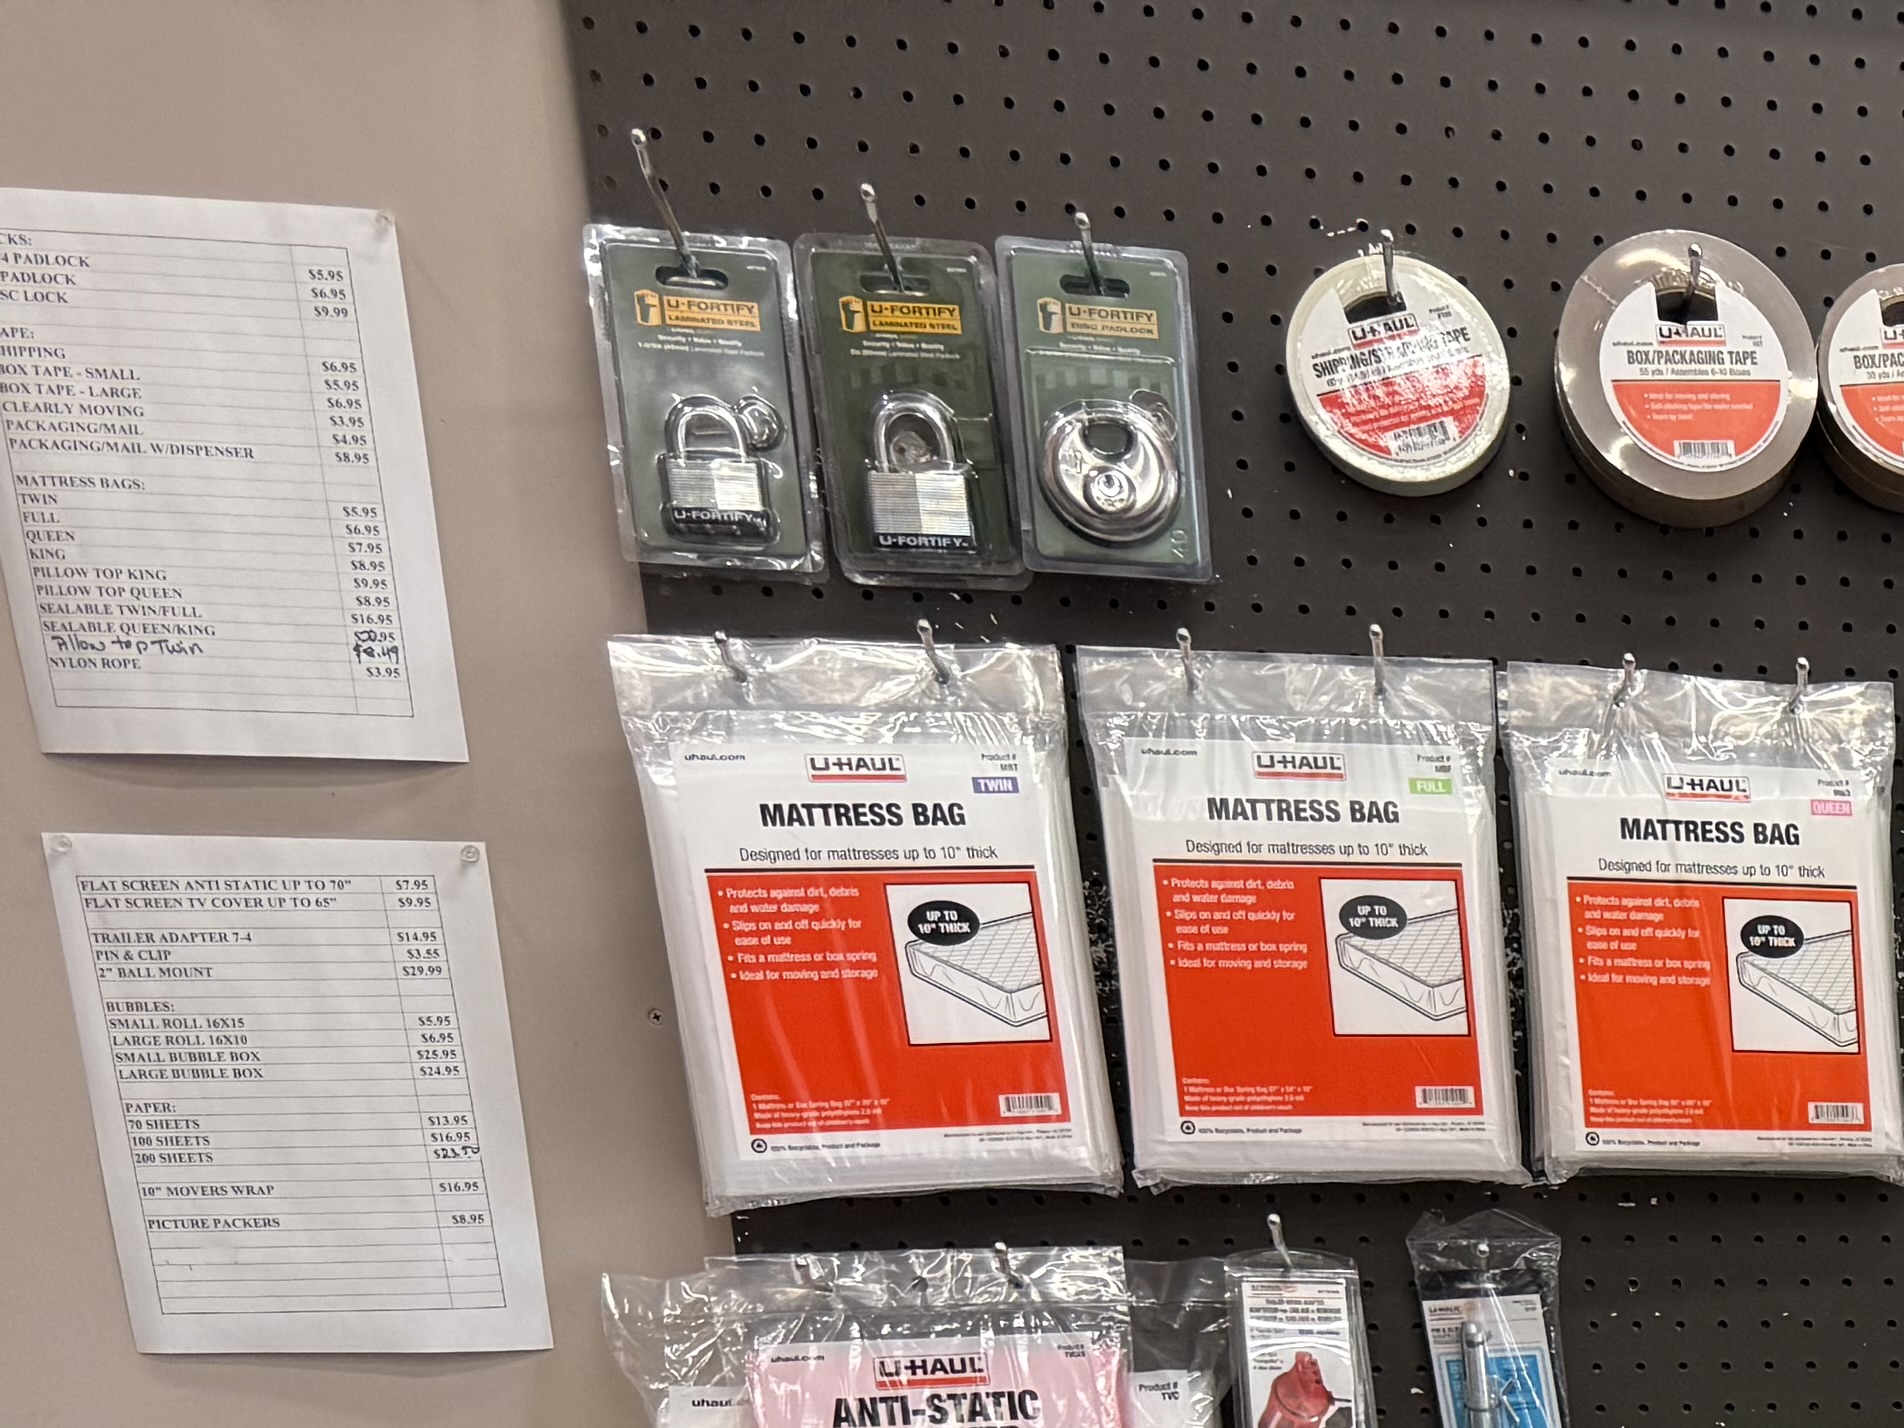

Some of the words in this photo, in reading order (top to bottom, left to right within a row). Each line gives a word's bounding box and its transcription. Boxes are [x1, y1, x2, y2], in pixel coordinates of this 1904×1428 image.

[666, 297, 756, 317] U-FORTIFY
[870, 303, 958, 319] U-FORTIFY
[667, 314, 723, 327] LAMINATED
[727, 318, 757, 331] STEEL
[1626, 349, 1723, 368] BOX/PACKAGING
[1728, 351, 1758, 367] TAPE
[16, 474, 96, 490] MATTRESS
[100, 476, 145, 490] BAGS:
[18, 493, 58, 506] TWIN
[342, 506, 377, 519] $5.95
[26, 530, 75, 544] QUEEN
[348, 542, 383, 555] $7.95
[49, 656, 98, 670] NYLON
[102, 658, 142, 670] ROPE
[366, 666, 400, 678] $3.95
[979, 779, 1013, 792] TWIN
[1416, 780, 1446, 793] FULL
[760, 803, 902, 827] MATTRESS
[913, 803, 965, 826] BAG
[739, 846, 801, 864] Designed
[805, 846, 823, 861] for
[827, 846, 899, 861] mattresses
[903, 848, 919, 863] up
[923, 847, 937, 860] to
[966, 844, 998, 859] thick
[80, 880, 116, 892] FLAT
[122, 879, 180, 892] SCREEN
[184, 879, 219, 892] ANTI
[224, 879, 278, 892] STATIC
[281, 879, 301, 891] UP
[305, 879, 325, 891] TO
[395, 879, 428, 891] $7.95
[117, 966, 155, 978] BALL
[159, 966, 213, 979] MOUNT
[402, 965, 442, 977] $29.99
[106, 1000, 175, 1013] BUBBLES:
[147, 1216, 210, 1230] PICTURE
[213, 1216, 280, 1229] PACKERS
[451, 1213, 484, 1226] $8.95
[832, 1389, 1040, 1428] ANTI-STATIC
